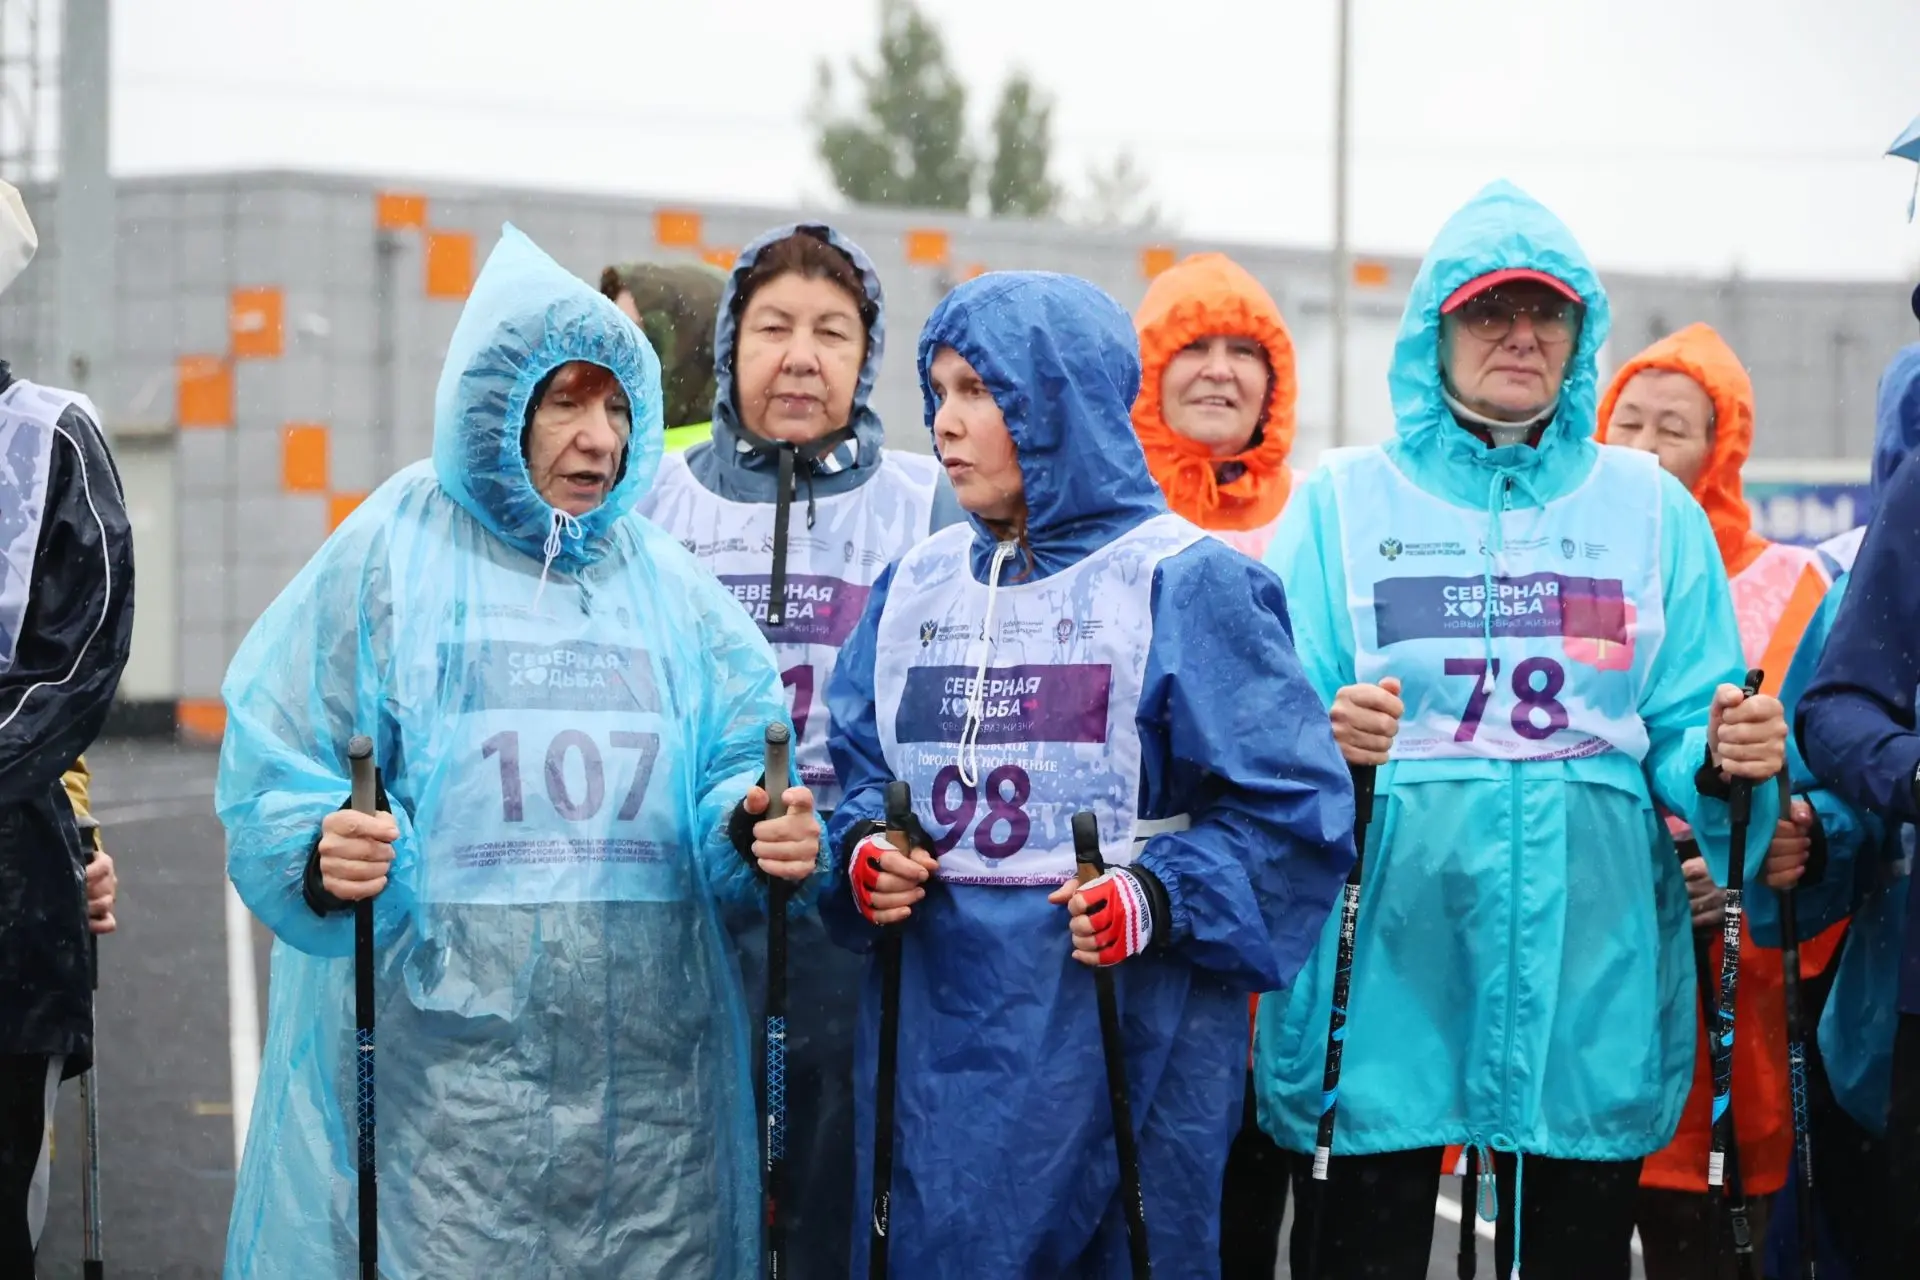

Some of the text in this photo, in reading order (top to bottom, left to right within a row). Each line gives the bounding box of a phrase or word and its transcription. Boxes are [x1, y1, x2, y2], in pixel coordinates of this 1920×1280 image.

[724, 583, 833, 602] ЕВЕНАЯ
[1443, 581, 1559, 600] СЕВЕРНАЯ
[944, 676, 1042, 697] СЕВЕРНАЯ
[1443, 656, 1569, 742] 78
[481, 728, 660, 822] 107
[931, 764, 1031, 860] 98
